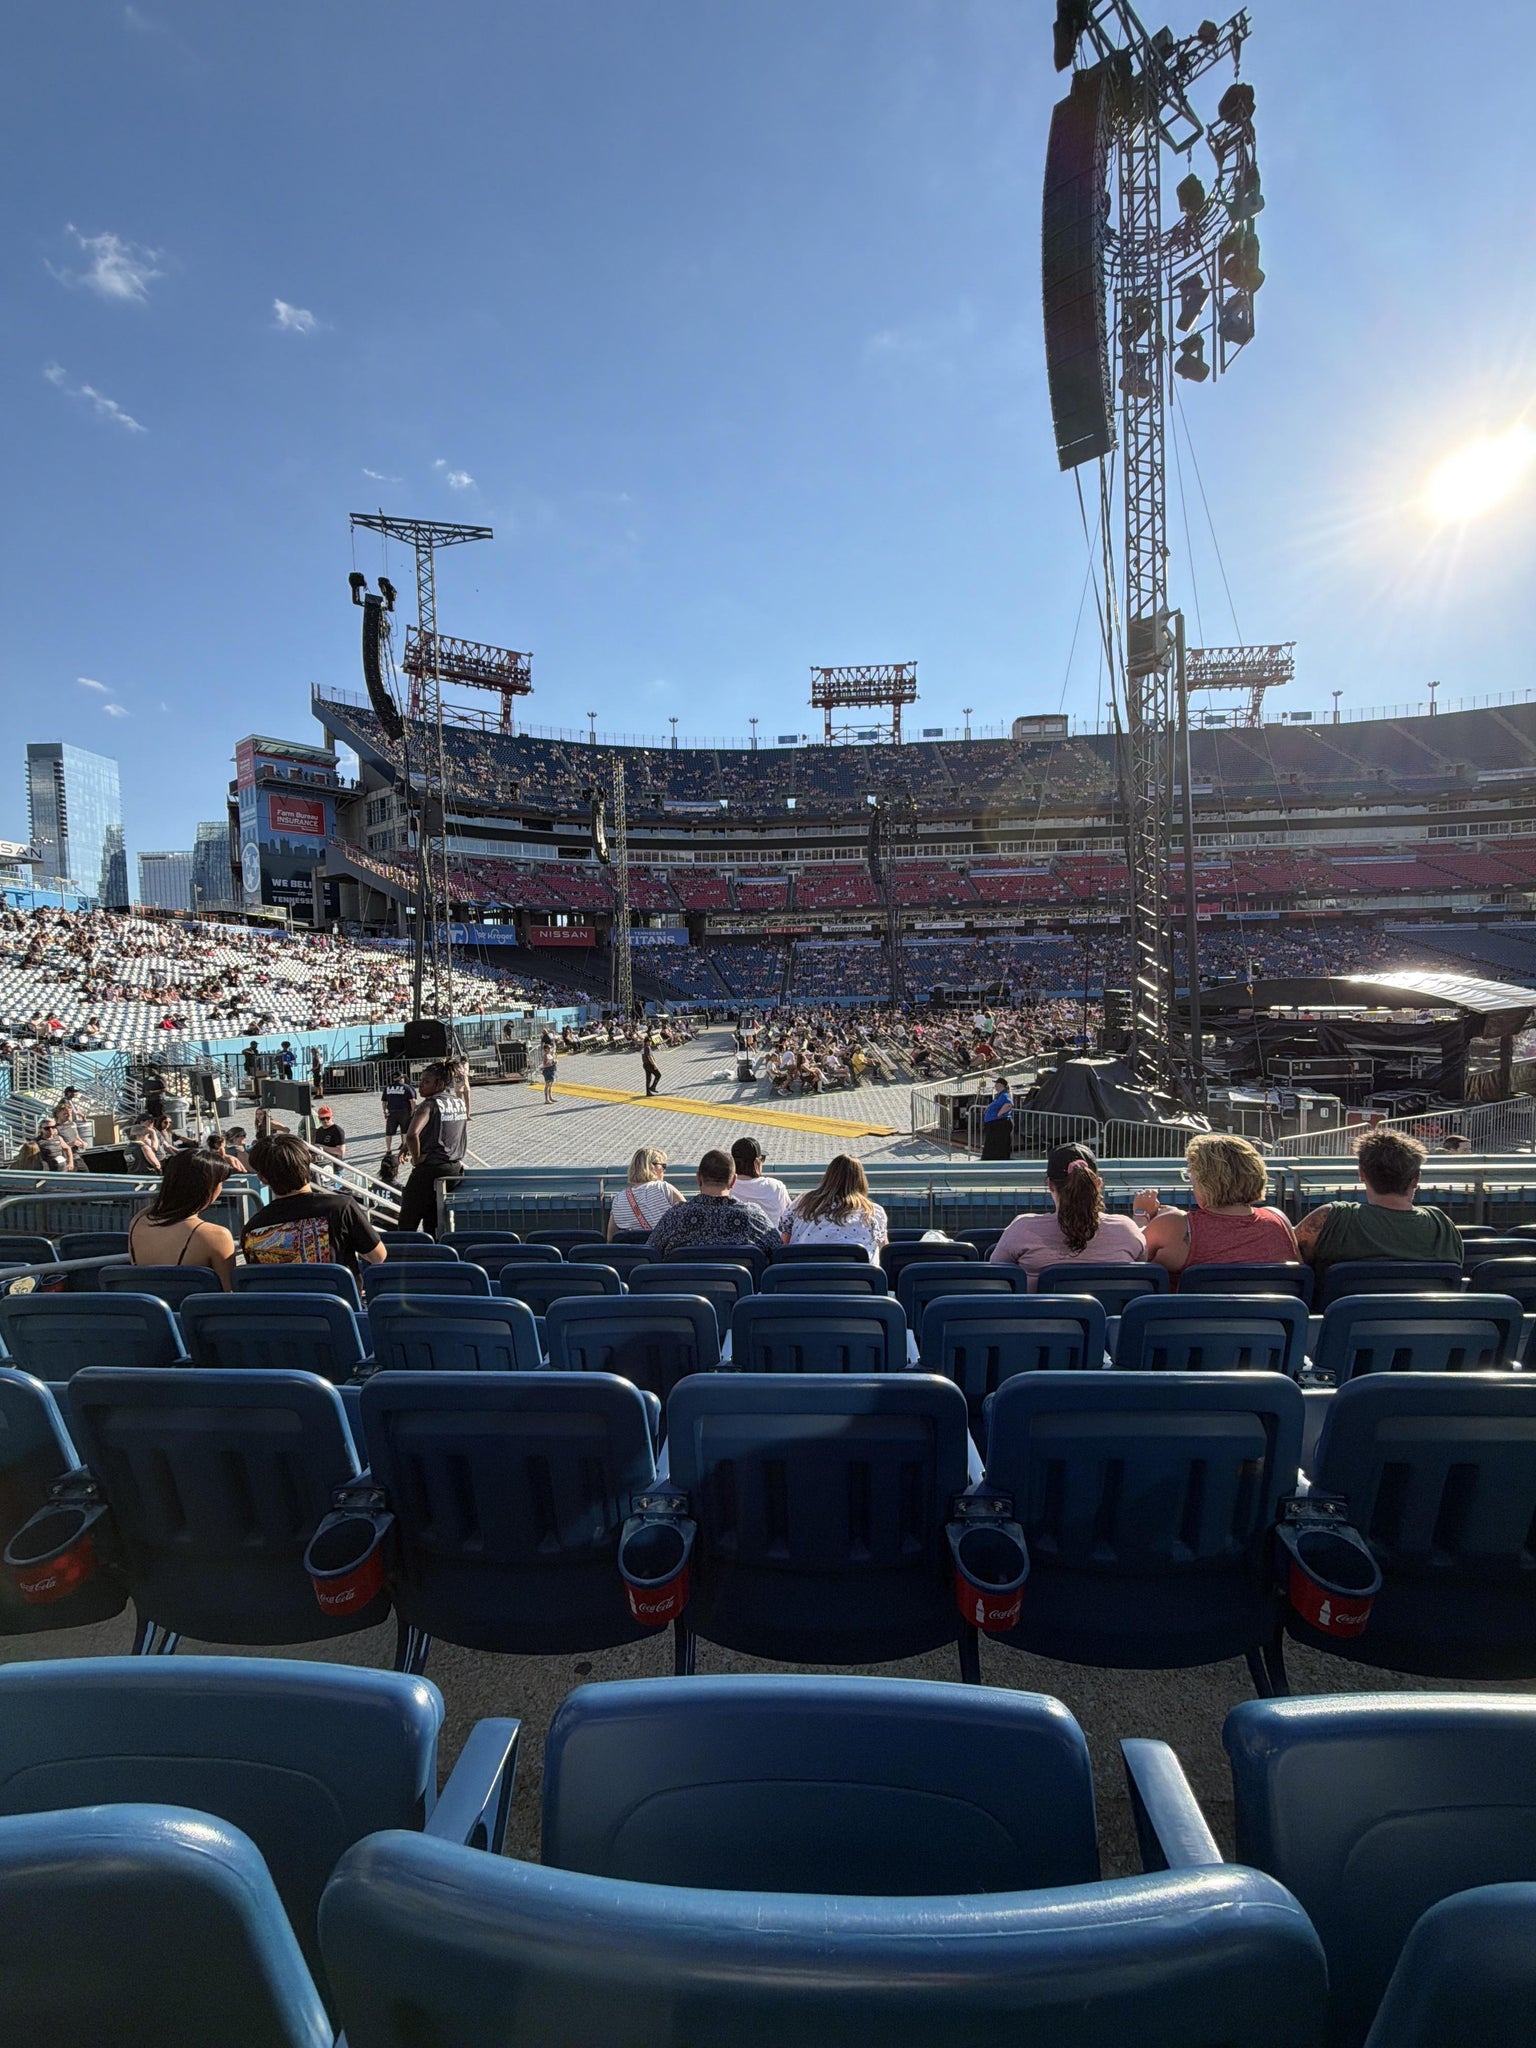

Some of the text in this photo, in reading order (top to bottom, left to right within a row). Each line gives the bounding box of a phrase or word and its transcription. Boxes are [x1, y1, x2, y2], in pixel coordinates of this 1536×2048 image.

[295, 811, 319, 820] Bureau
[276, 816, 319, 827] INSURANCE
[271, 878, 331, 890] WE BELIE
[487, 928, 513, 945] Kroger
[539, 930, 588, 938] NISSAN
[627, 935, 676, 945] TITANS
